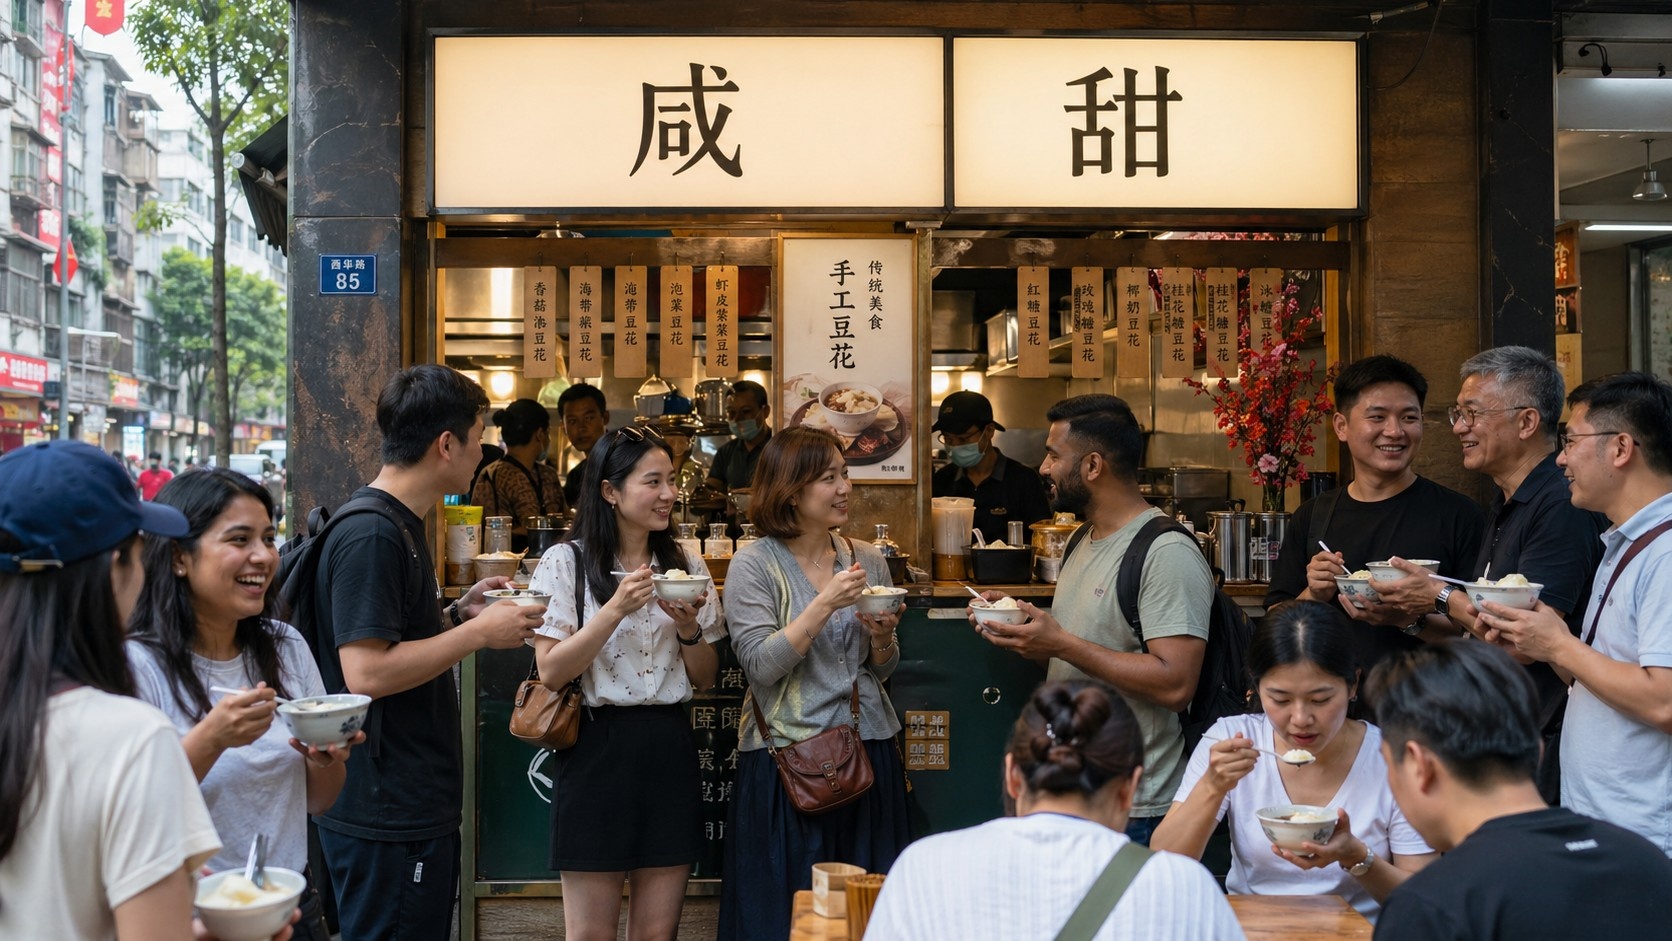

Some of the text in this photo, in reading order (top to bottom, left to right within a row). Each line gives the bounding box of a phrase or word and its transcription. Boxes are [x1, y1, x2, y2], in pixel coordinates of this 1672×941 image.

[629, 63, 743, 177] 咸
[1064, 66, 1183, 178] 甜
[336, 273, 360, 290] 85
[829, 259, 856, 370] 手工豆花
[868, 260, 884, 331] 传统美食
